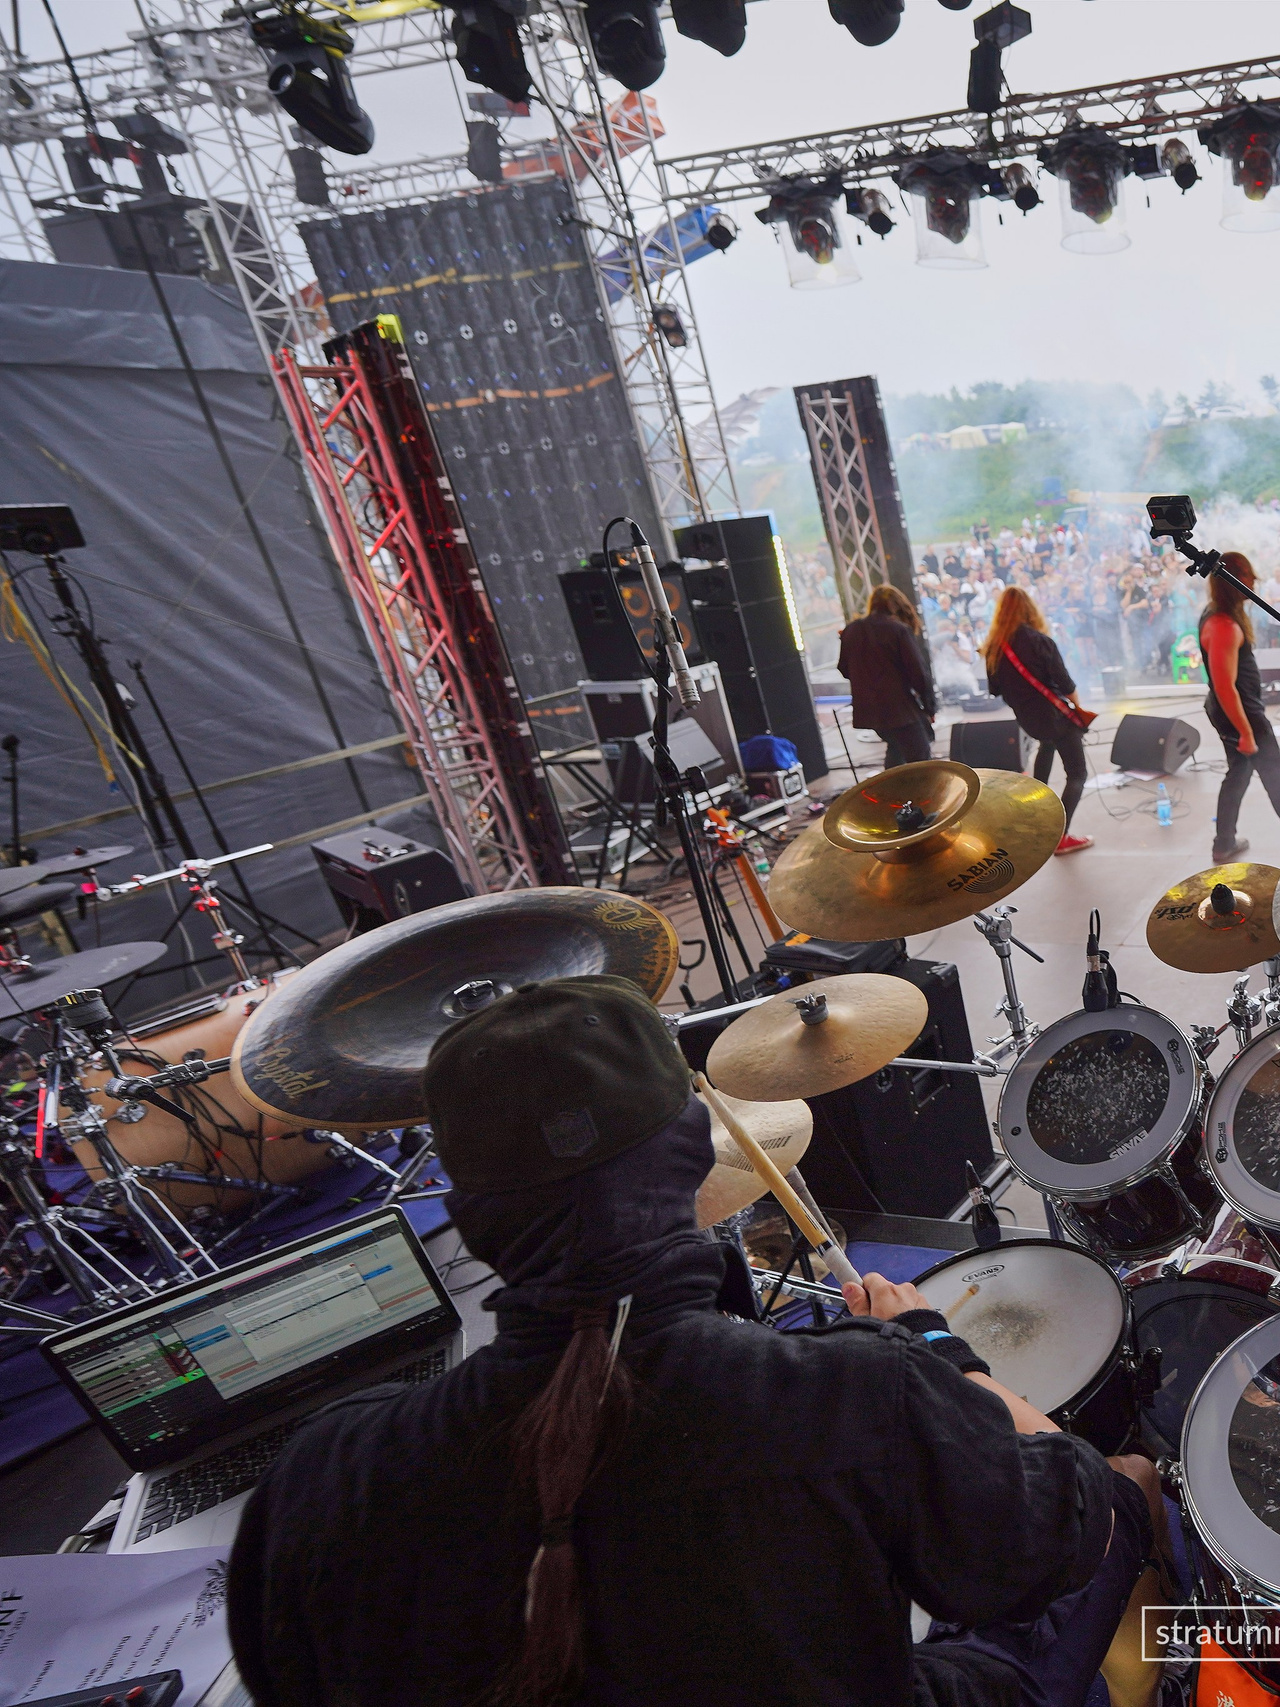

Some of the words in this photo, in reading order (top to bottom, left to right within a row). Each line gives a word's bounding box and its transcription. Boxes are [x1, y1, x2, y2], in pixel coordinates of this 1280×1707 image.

[946, 847, 1009, 892] SABIAN
[1109, 1129, 1149, 1161] EVANS
[967, 1266, 1000, 1281] EVANS
